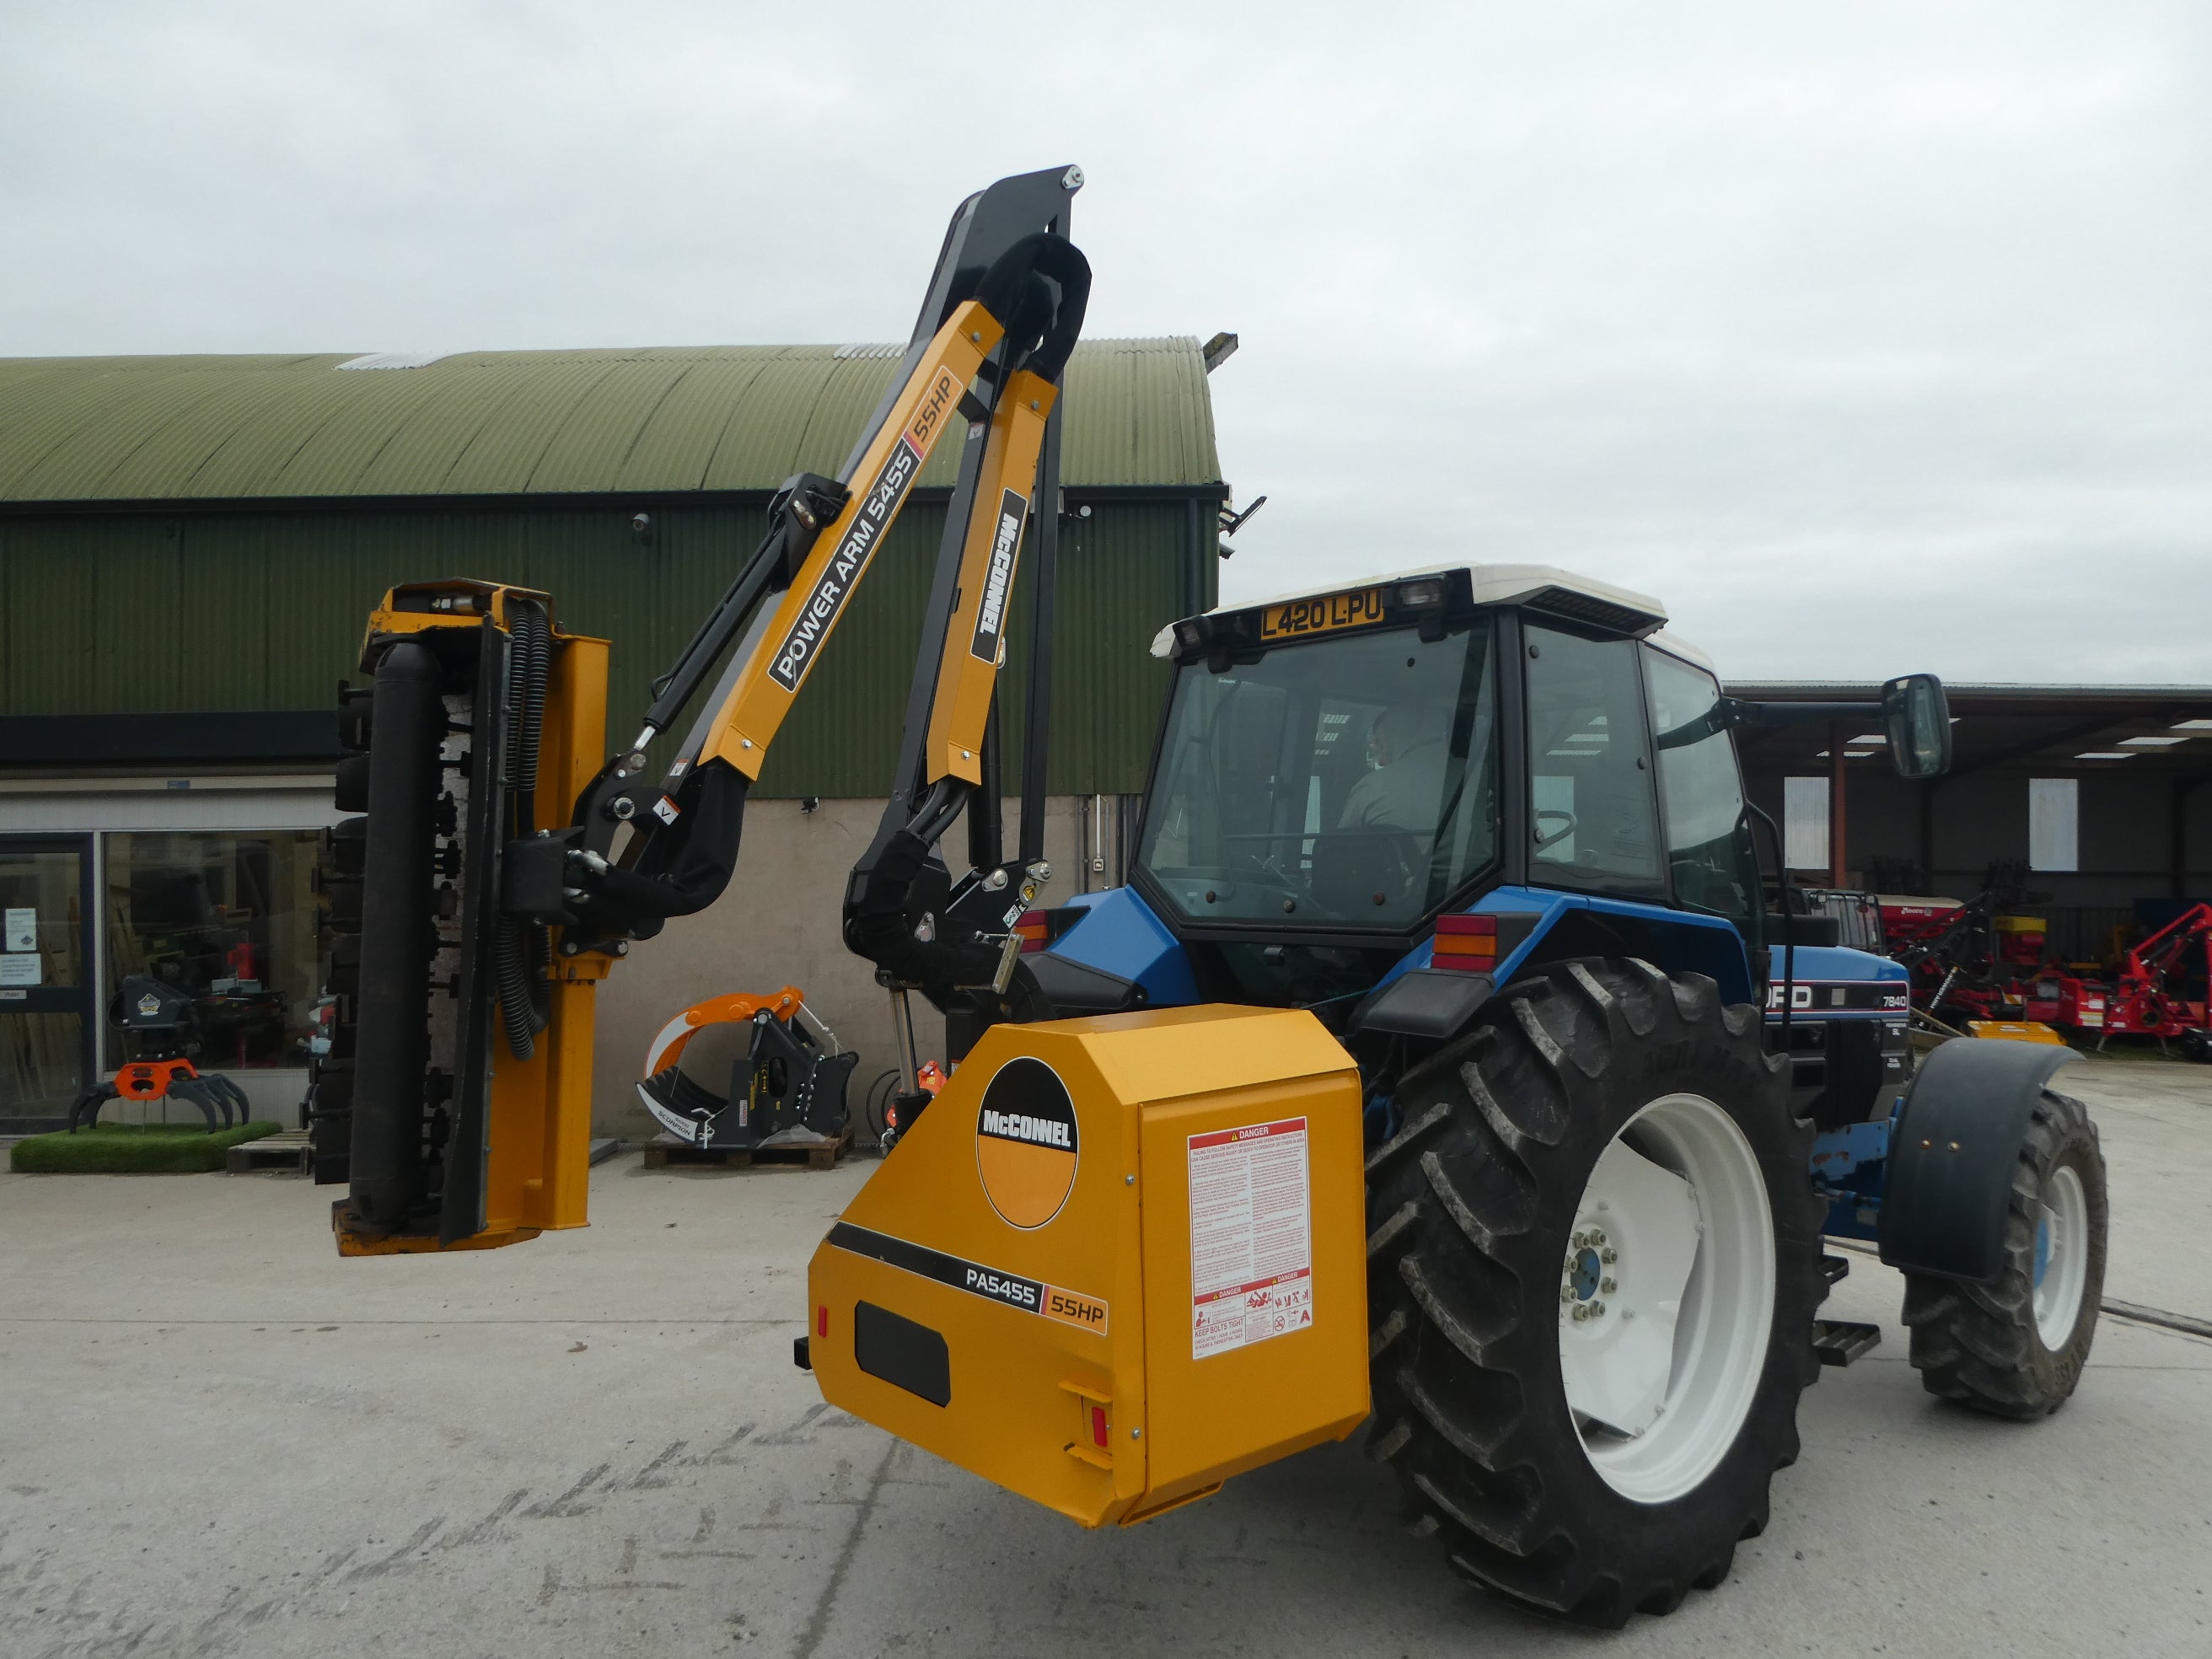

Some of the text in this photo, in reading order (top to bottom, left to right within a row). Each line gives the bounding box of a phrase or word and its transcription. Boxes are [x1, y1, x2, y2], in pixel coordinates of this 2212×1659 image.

[778, 376, 951, 679] POWER ARM 5455 55HP
[980, 513, 1019, 635] McCONNEL
[1263, 590, 1382, 636] L420 LPU
[1882, 996, 1906, 1007] 7840
[658, 1110, 691, 1136] SCORPION
[983, 1109, 1071, 1147] McCONNEL
[1239, 1126, 1269, 1139] DANGER
[1277, 1271, 1298, 1282] DANGER
[966, 1268, 1103, 1323] PA5455 55HP
[1219, 1286, 1242, 1298] DANGER
[1195, 1327, 1210, 1338] KEEP
[1210, 1323, 1227, 1334] BOLTS
[1228, 1318, 1244, 1329] TIGHT
